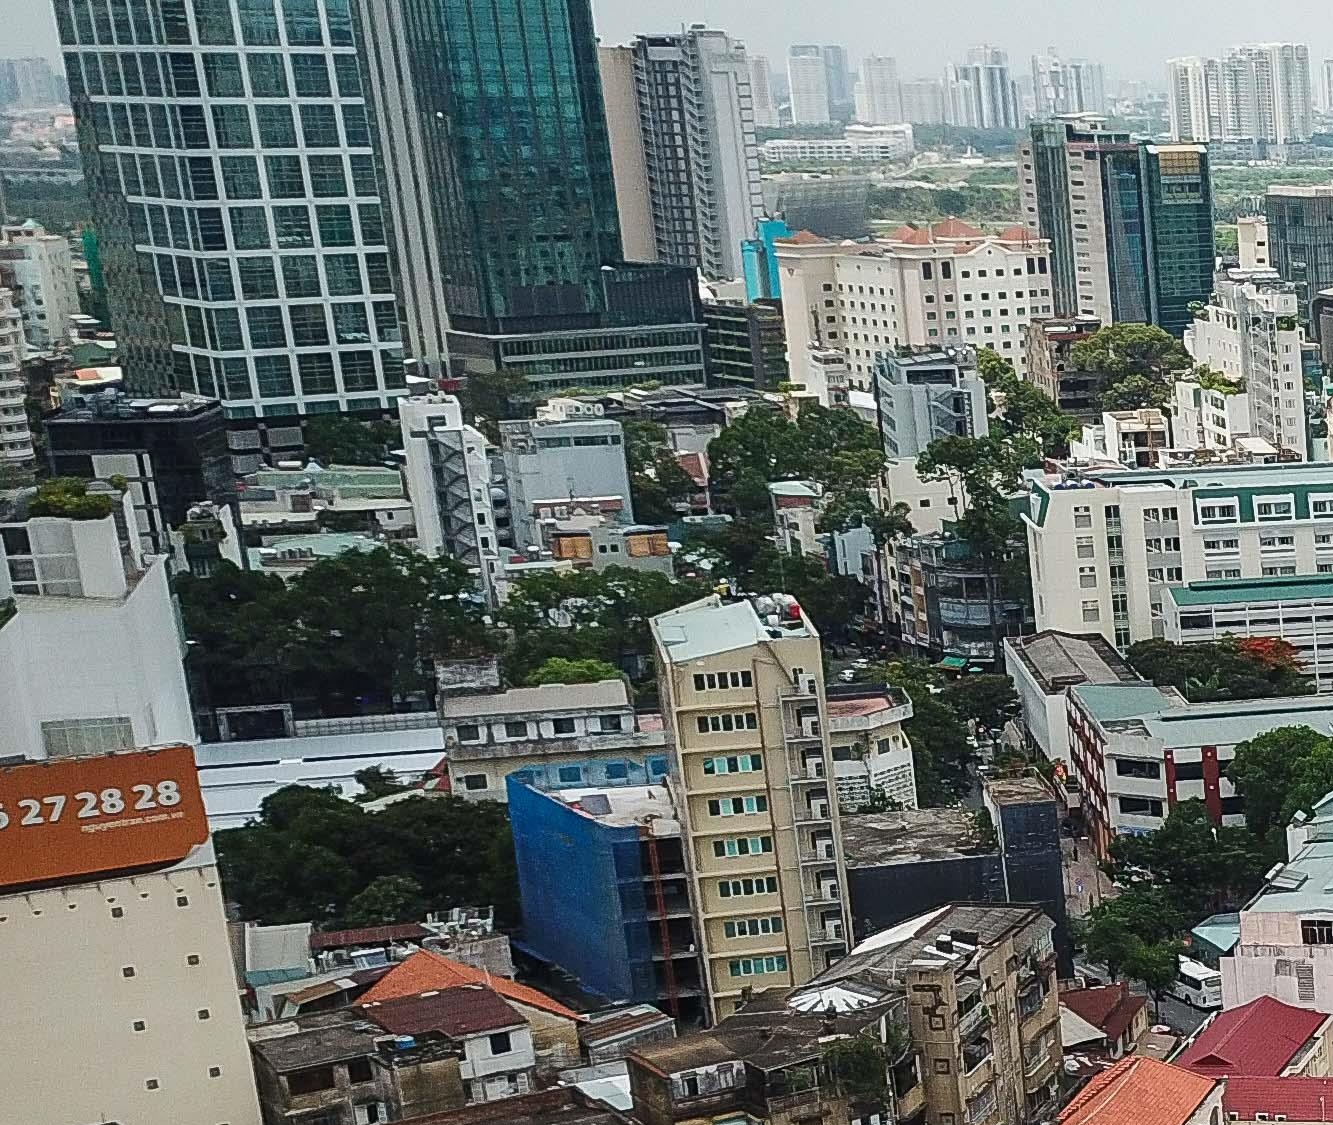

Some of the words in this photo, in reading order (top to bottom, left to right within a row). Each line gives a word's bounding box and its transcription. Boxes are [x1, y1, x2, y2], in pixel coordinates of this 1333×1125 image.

[18, 795, 66, 826] 27
[74, 788, 125, 819] 28
[131, 780, 181, 810] 28
